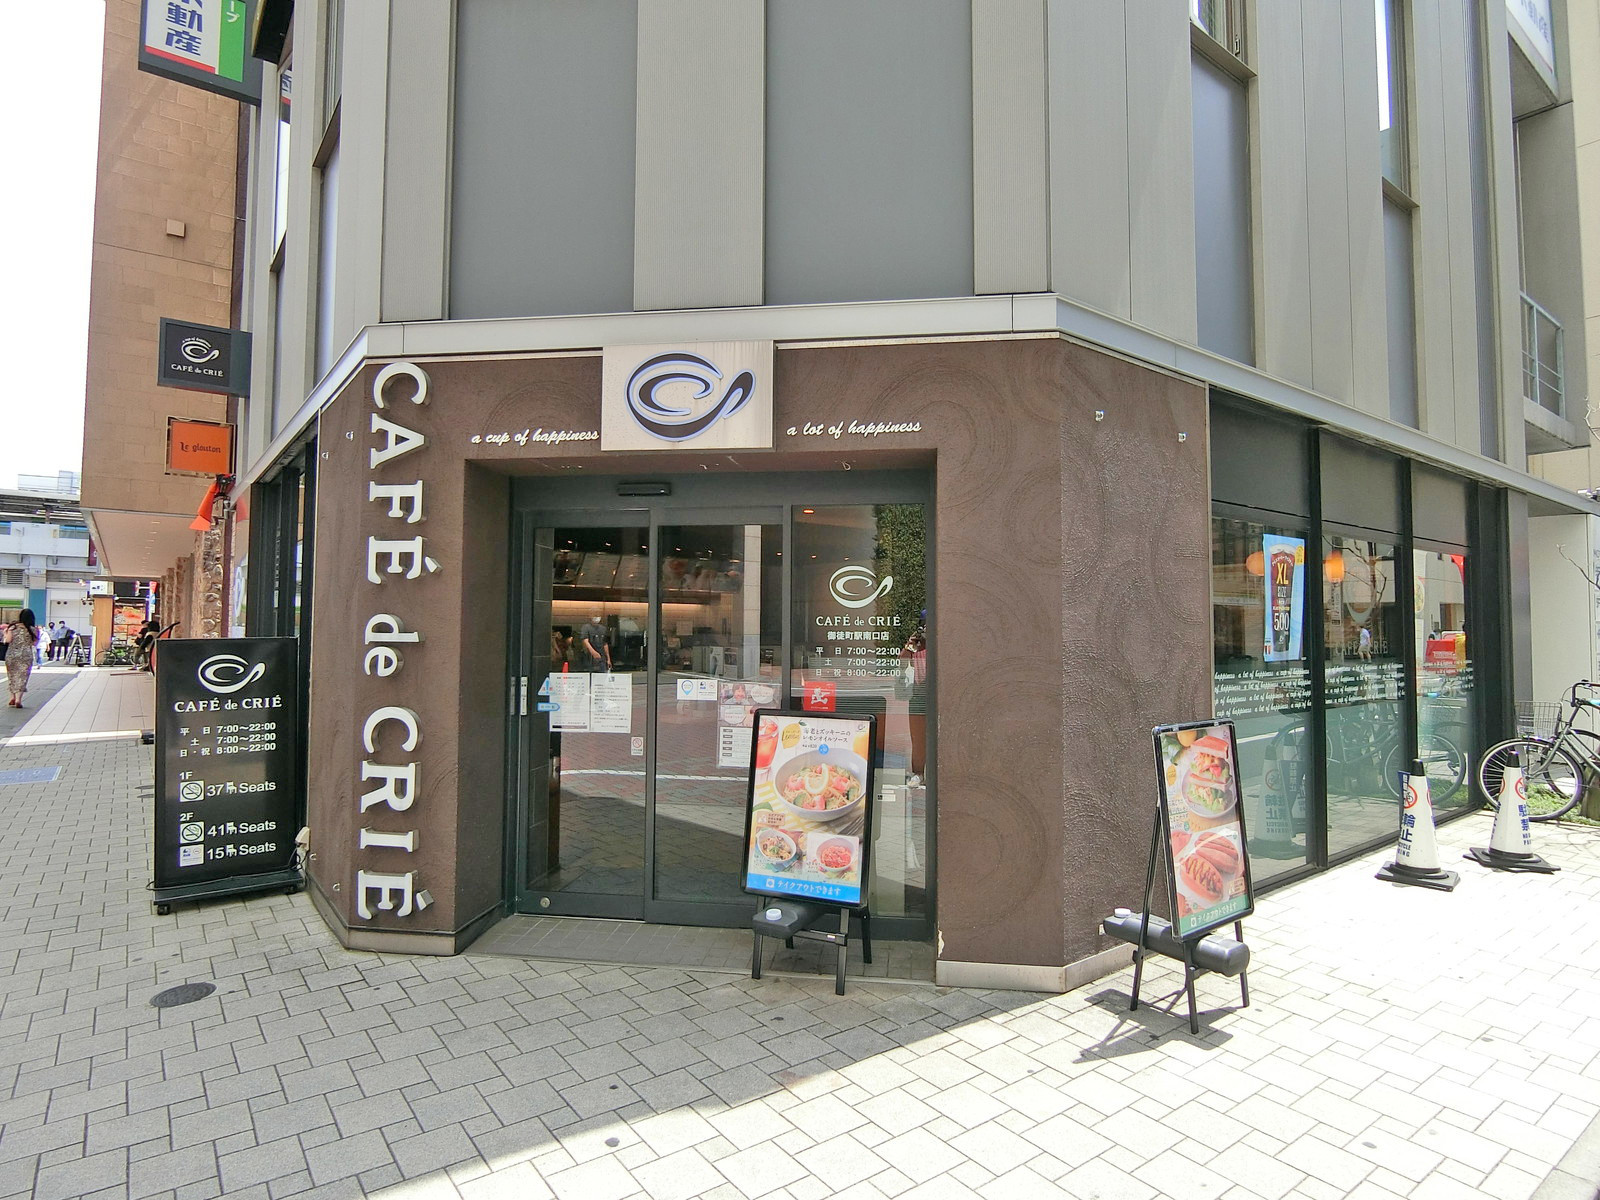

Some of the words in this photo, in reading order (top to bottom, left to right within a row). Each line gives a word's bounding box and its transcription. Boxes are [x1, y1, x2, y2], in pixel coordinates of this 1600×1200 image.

[165, 0, 203, 56] 動産
[171, 363, 194, 373] CAFÉ
[203, 368, 224, 377] CRIÉ
[471, 433, 481, 444] a
[485, 432, 511, 446] cup
[514, 429, 530, 446] of
[532, 428, 600, 445] happiness
[787, 426, 797, 436] a
[803, 422, 824, 436] lot
[828, 421, 844, 439] of
[848, 419, 922, 437] happiness
[368, 361, 437, 584] CAFÉ
[1276, 562, 1290, 585] XL
[816, 613, 851, 627] CAFÉ
[854, 616, 865, 627] de
[868, 614, 901, 627] CRIÉ
[1273, 612, 1290, 632] 500
[364, 613, 420, 677] de
[827, 631, 890, 641] 御徒町駅南口店
[174, 697, 220, 713] CAFÉ
[224, 699, 238, 710] de
[242, 694, 282, 709] CRIÉ
[190, 738, 200, 746] 土
[180, 771, 193, 780] 1F
[207, 784, 224, 797] 37
[239, 781, 276, 794] Seats
[180, 812, 194, 822] 2F
[357, 706, 431, 920] CRIÉ
[207, 824, 225, 837] 41
[239, 820, 276, 834] Seats
[207, 847, 225, 860] 15
[239, 842, 276, 856] Seats
[777, 881, 841, 896] テイクアウトできます
